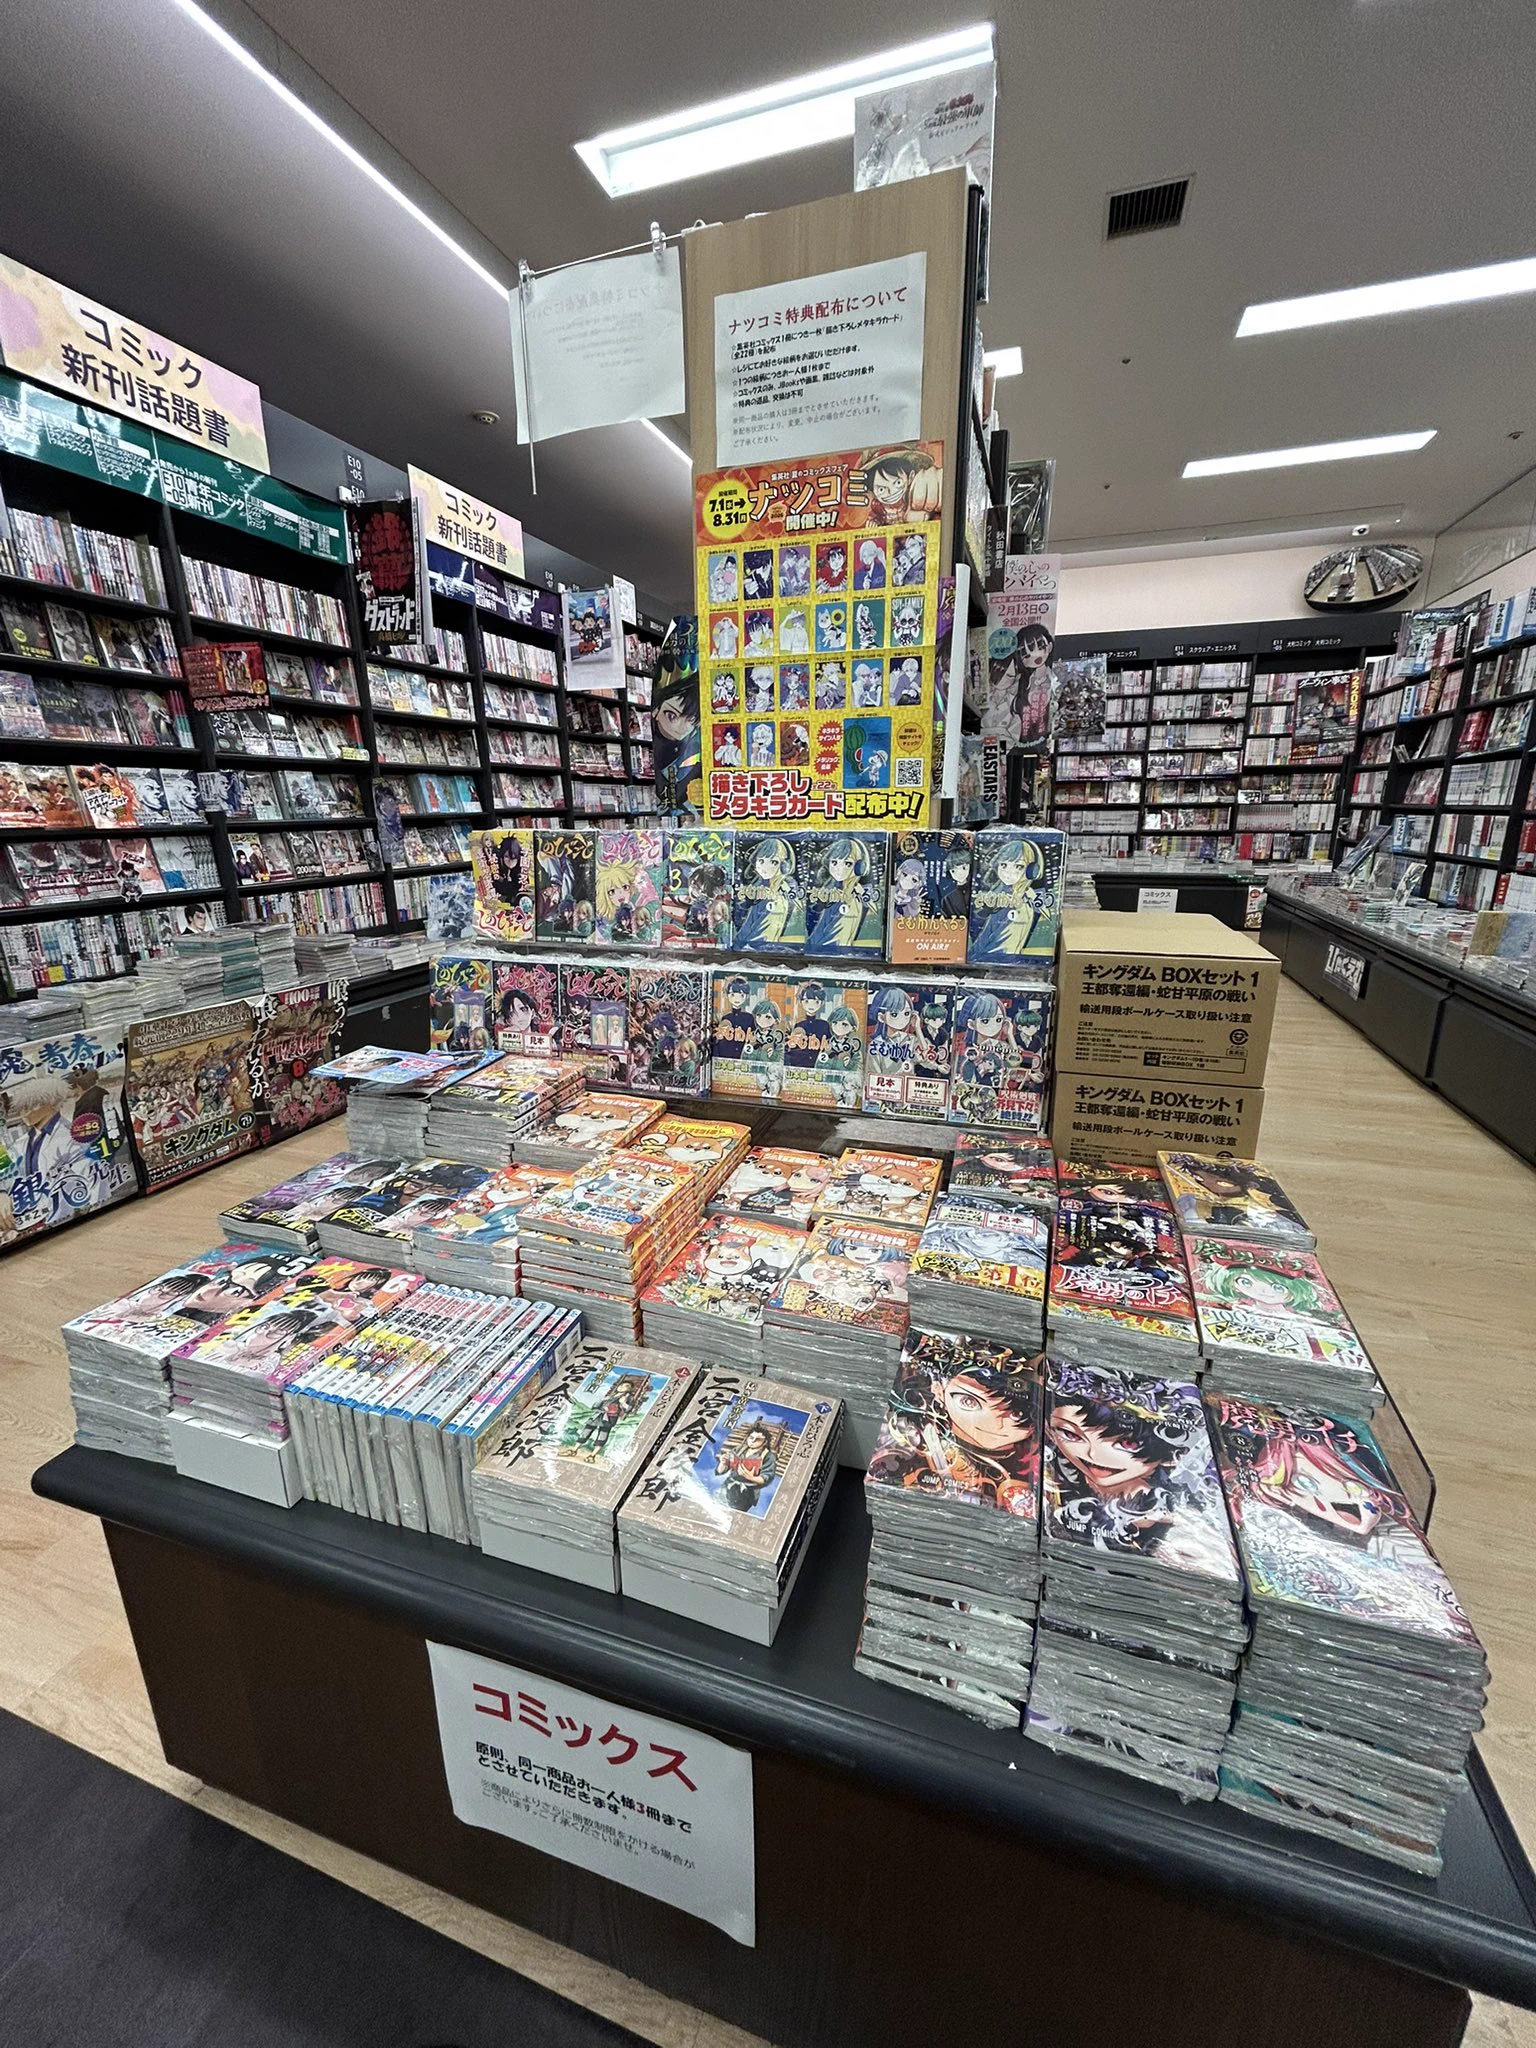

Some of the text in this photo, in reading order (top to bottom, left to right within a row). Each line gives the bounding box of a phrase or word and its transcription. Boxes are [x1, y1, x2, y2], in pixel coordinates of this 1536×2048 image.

[728, 287, 907, 335] ナツコミ特典配布について
[79, 307, 203, 390] コミック
[63, 342, 230, 448] 新刊話題書
[347, 456, 361, 471] E10
[350, 469, 363, 482] -05
[164, 473, 183, 490] E10
[185, 479, 245, 511] 青年コミック
[187, 497, 214, 516] 新刊
[749, 469, 869, 522] ナツコミ
[445, 491, 498, 532] コミック
[785, 511, 836, 532] 開催中!
[437, 514, 508, 566] 新刊話題書
[994, 531, 1005, 569] 秋田書店
[1299, 674, 1350, 689] ダーウィン事変
[710, 770, 811, 794] 描き下ろし
[983, 736, 999, 803] BEASTARS
[710, 791, 924, 819] メタキラカード 配布中!
[1083, 964, 1260, 987] キングダム BOXセット 1
[1081, 982, 1256, 1003] 王都奪還編・蛇甘平原の戦い
[327, 979, 350, 1037] 喰うか、
[1079, 1003, 1253, 1024] 輸送用段ボールケース取り扱い注意
[248, 993, 278, 1100] 喰われるか。
[529, 1037, 545, 1045] 見本
[876, 1076, 895, 1087] 見本
[914, 1081, 939, 1089] 特典あり
[1074, 1084, 1244, 1112] キングダム BOXセット 1
[1073, 1101, 1241, 1127] 王都奪還編・蛇甘平原の戦い
[164, 1118, 239, 1157] キングダム
[1072, 1121, 1238, 1147] 輸送用段ボールケース取り扱い注意
[678, 1368, 688, 1378] 上
[493, 1346, 609, 1467] 二宮金次郎
[817, 1402, 829, 1414] 下
[921, 1475, 968, 1490] JUMP COMICS
[1066, 1520, 1120, 1541] JUMP COMICS
[473, 1683, 698, 1792] コミックス
[475, 1741, 692, 1834] 原則、同一商品お一人様3冊まで
[478, 1755, 628, 1820] とさせていただきます。
